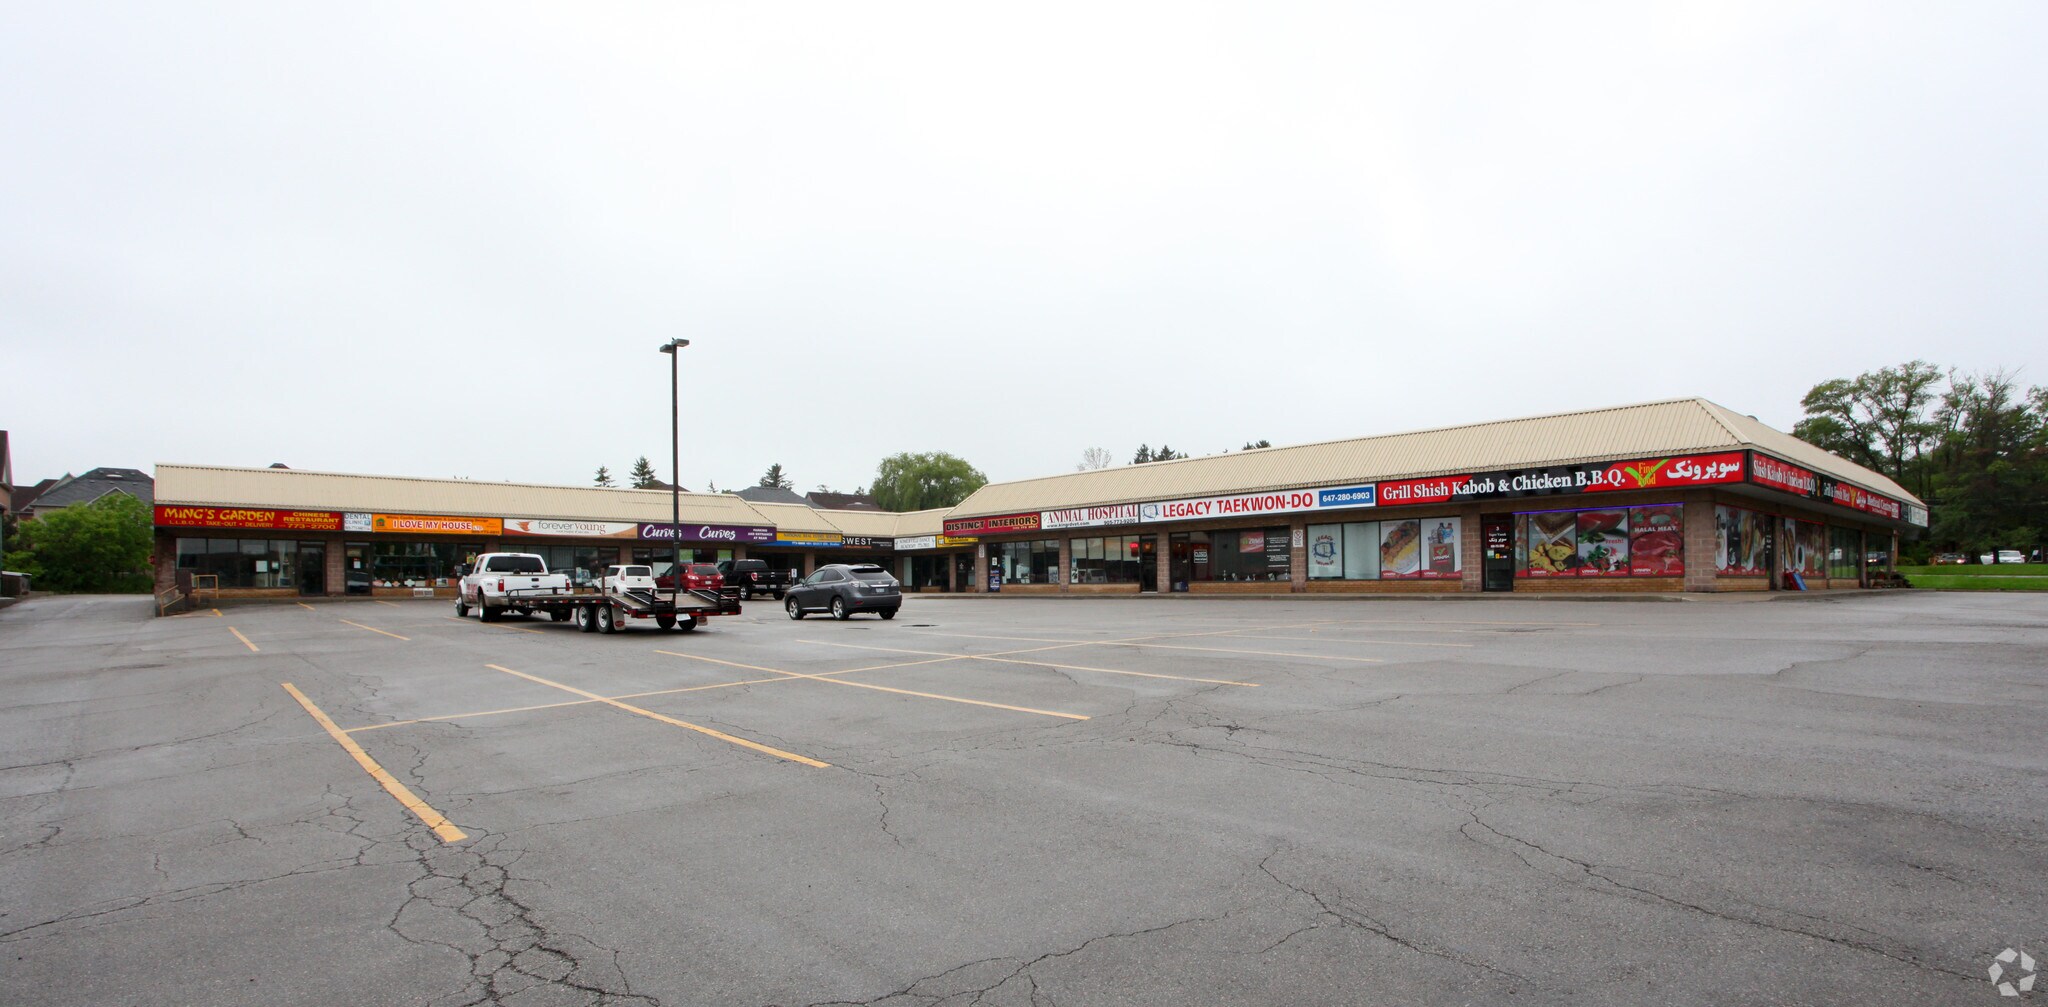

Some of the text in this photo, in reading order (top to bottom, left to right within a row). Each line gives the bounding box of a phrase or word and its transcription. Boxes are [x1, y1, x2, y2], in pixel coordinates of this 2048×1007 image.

[1753, 460, 1766, 478] Shish
[1767, 464, 1782, 483] Kabob
[1383, 469, 1626, 500] Grill Shish Kabob & Chicken B.B.Q.
[1322, 492, 1370, 502] 647-280-6903
[1162, 492, 1314, 518] LEGACY TAEKWON-DO
[164, 508, 275, 522] MING'S GARDEN
[1048, 504, 1138, 524] ANIMAL HOSPITAL
[393, 520, 398, 528] I
[400, 520, 423, 528] LOVE
[425, 521, 439, 529] MY
[441, 522, 472, 530] HOUSE
[946, 520, 985, 531] DISTINCT
[988, 516, 1038, 529] INTERIORS
[699, 526, 736, 540] Curves
